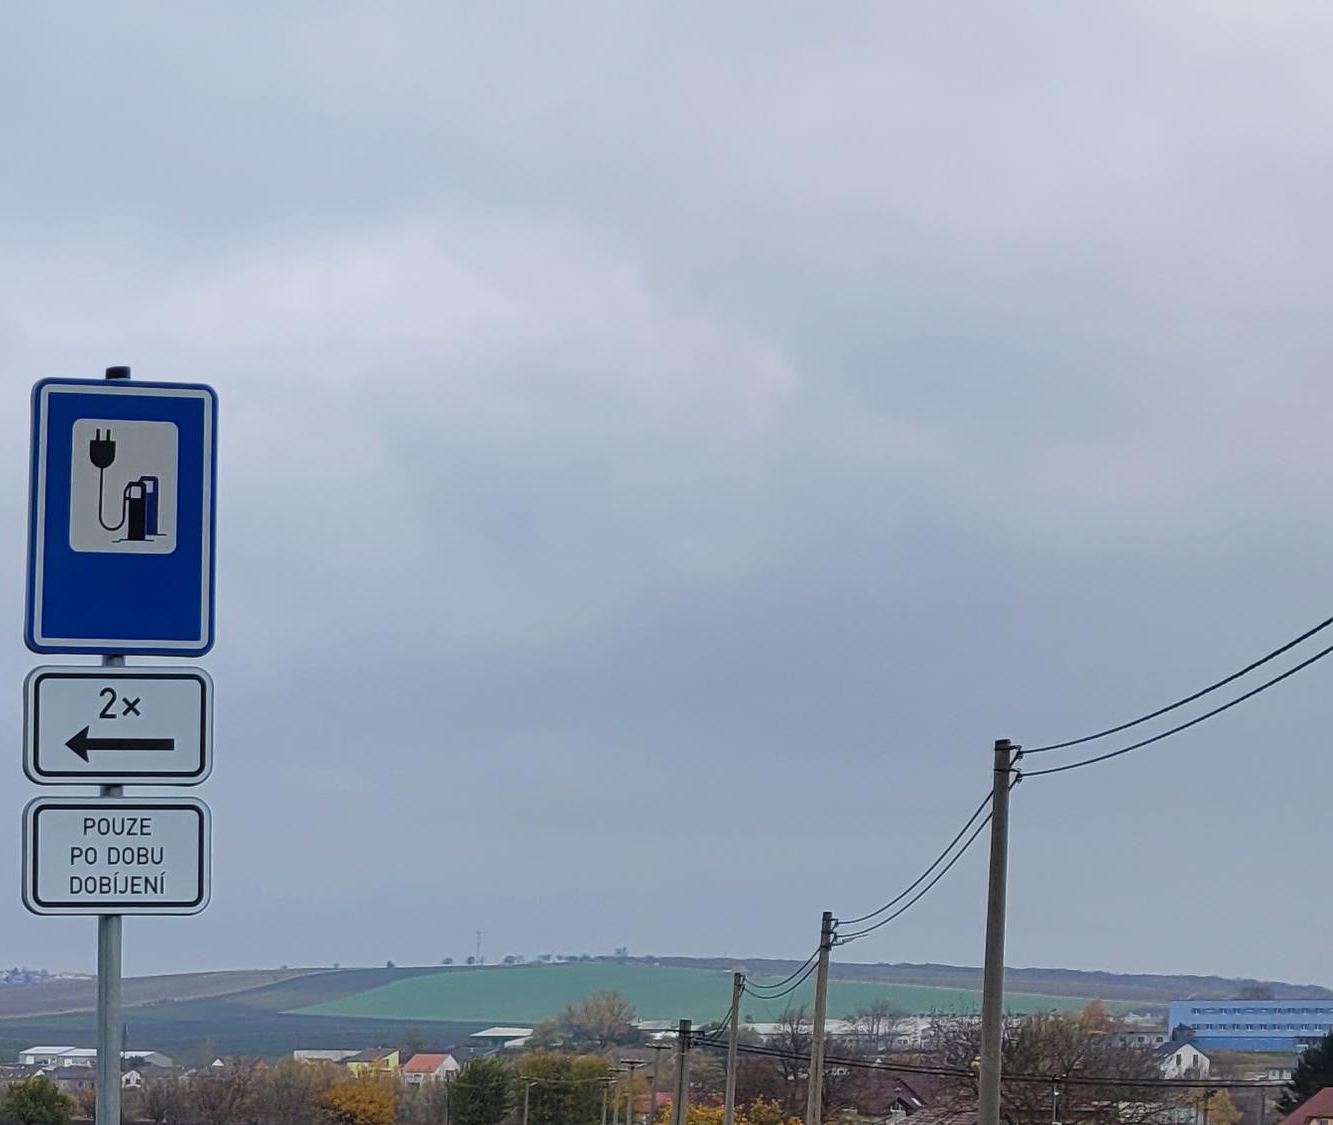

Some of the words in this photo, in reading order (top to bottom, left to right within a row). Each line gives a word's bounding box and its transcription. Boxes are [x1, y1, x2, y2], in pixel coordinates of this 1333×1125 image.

[83, 817, 152, 836] POUZE
[70, 847, 97, 865] PO
[107, 847, 164, 865] DOBU
[69, 871, 165, 894] DOBÍJENÍ
